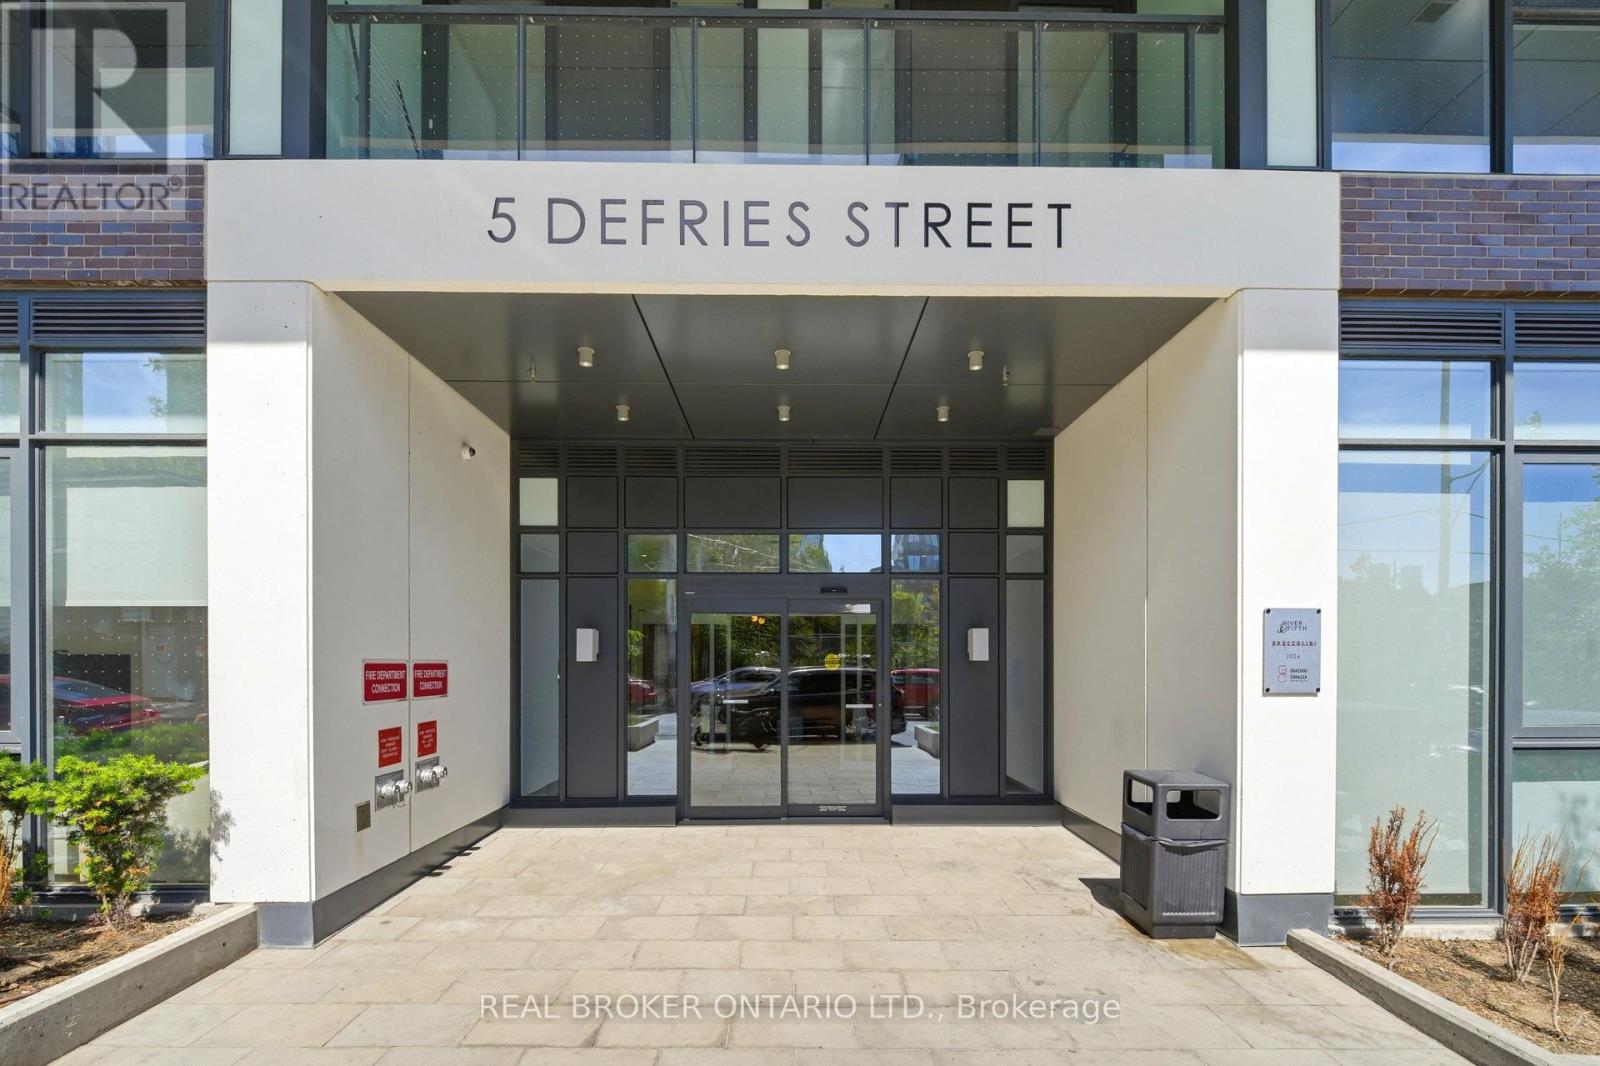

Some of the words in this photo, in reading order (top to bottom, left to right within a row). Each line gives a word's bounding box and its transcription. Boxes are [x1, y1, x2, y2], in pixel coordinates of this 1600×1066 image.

[487, 197, 516, 243] 5
[547, 198, 810, 247] DEFRIES
[844, 202, 1071, 248] STREET
[365, 670, 377, 680] FIRE
[377, 669, 406, 680] DEPARTMENT
[414, 669, 423, 679] FIRE
[371, 683, 401, 694] CONNECTION
[419, 681, 442, 690] CONNECTION
